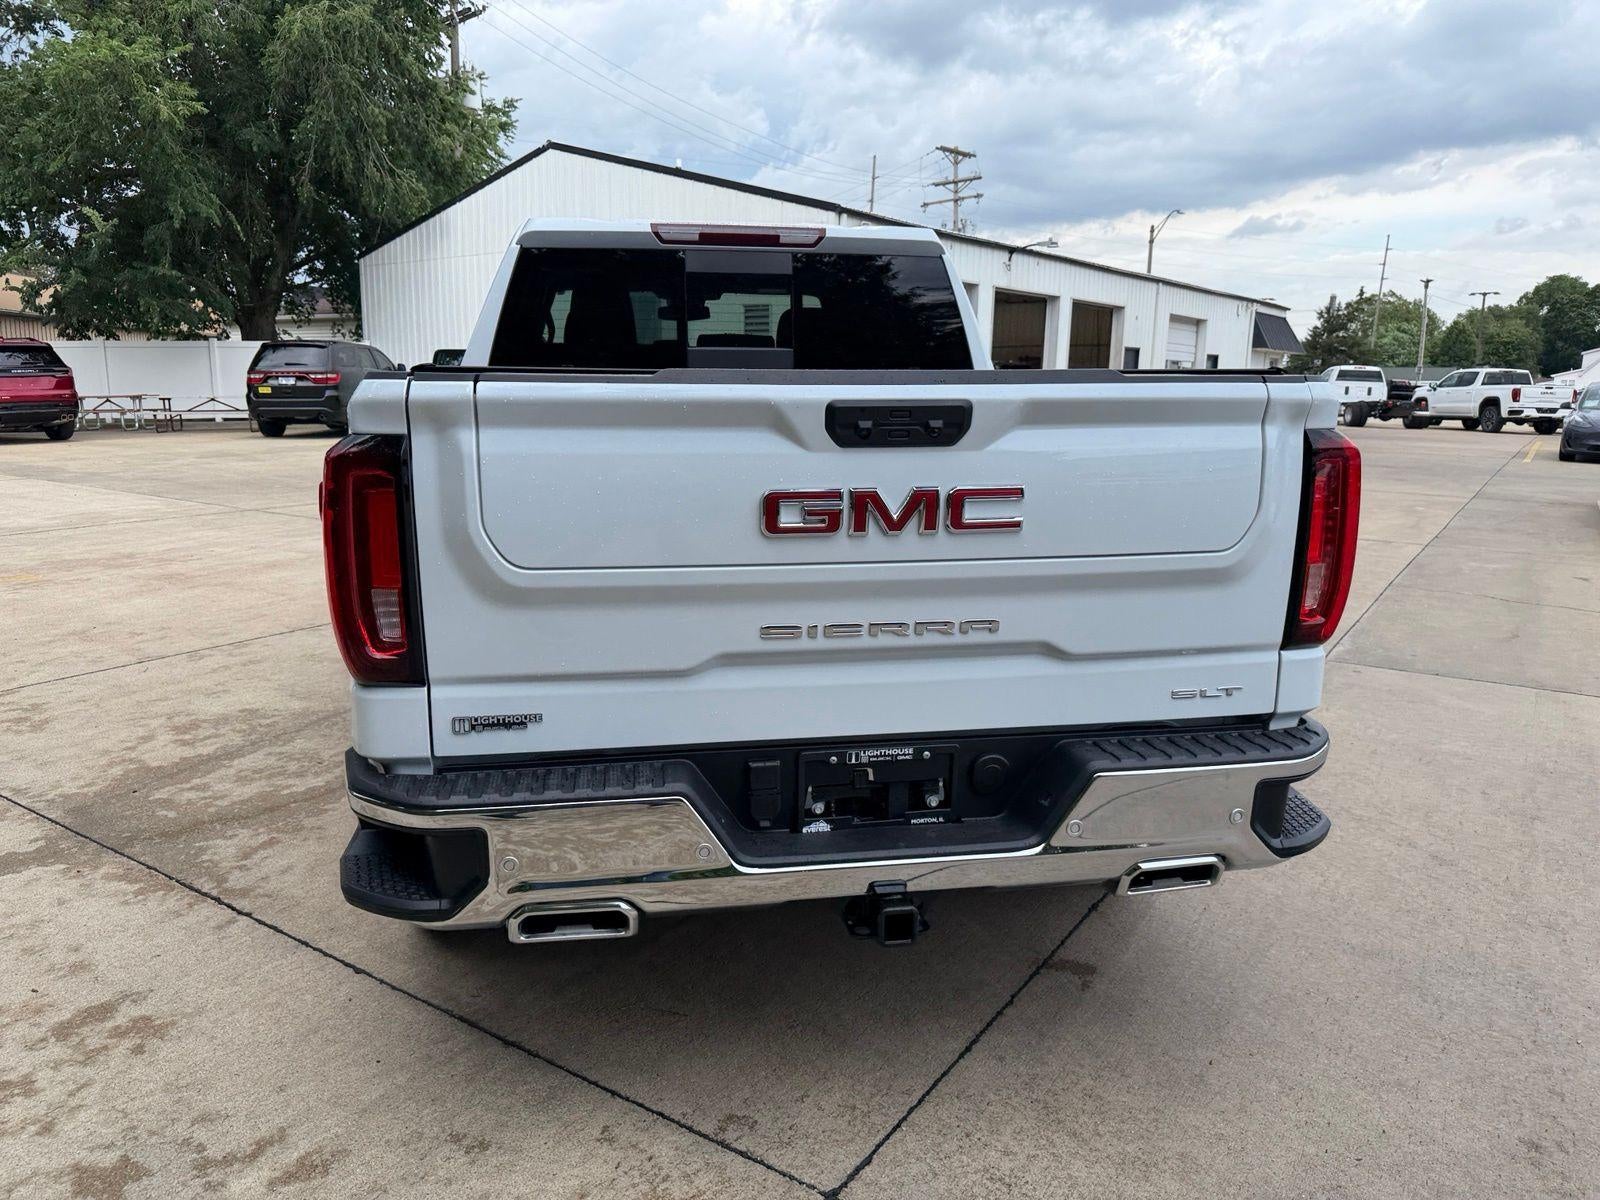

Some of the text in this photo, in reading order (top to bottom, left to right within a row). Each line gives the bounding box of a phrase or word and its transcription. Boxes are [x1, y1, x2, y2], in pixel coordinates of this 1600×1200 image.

[760, 485, 1025, 537] GMC
[760, 618, 1001, 640] SIERRA
[1171, 685, 1244, 700] SLT
[471, 714, 543, 724] LIGHTHOUSE
[861, 748, 914, 756] LIGHTHOUSE
[802, 824, 831, 834] everest
